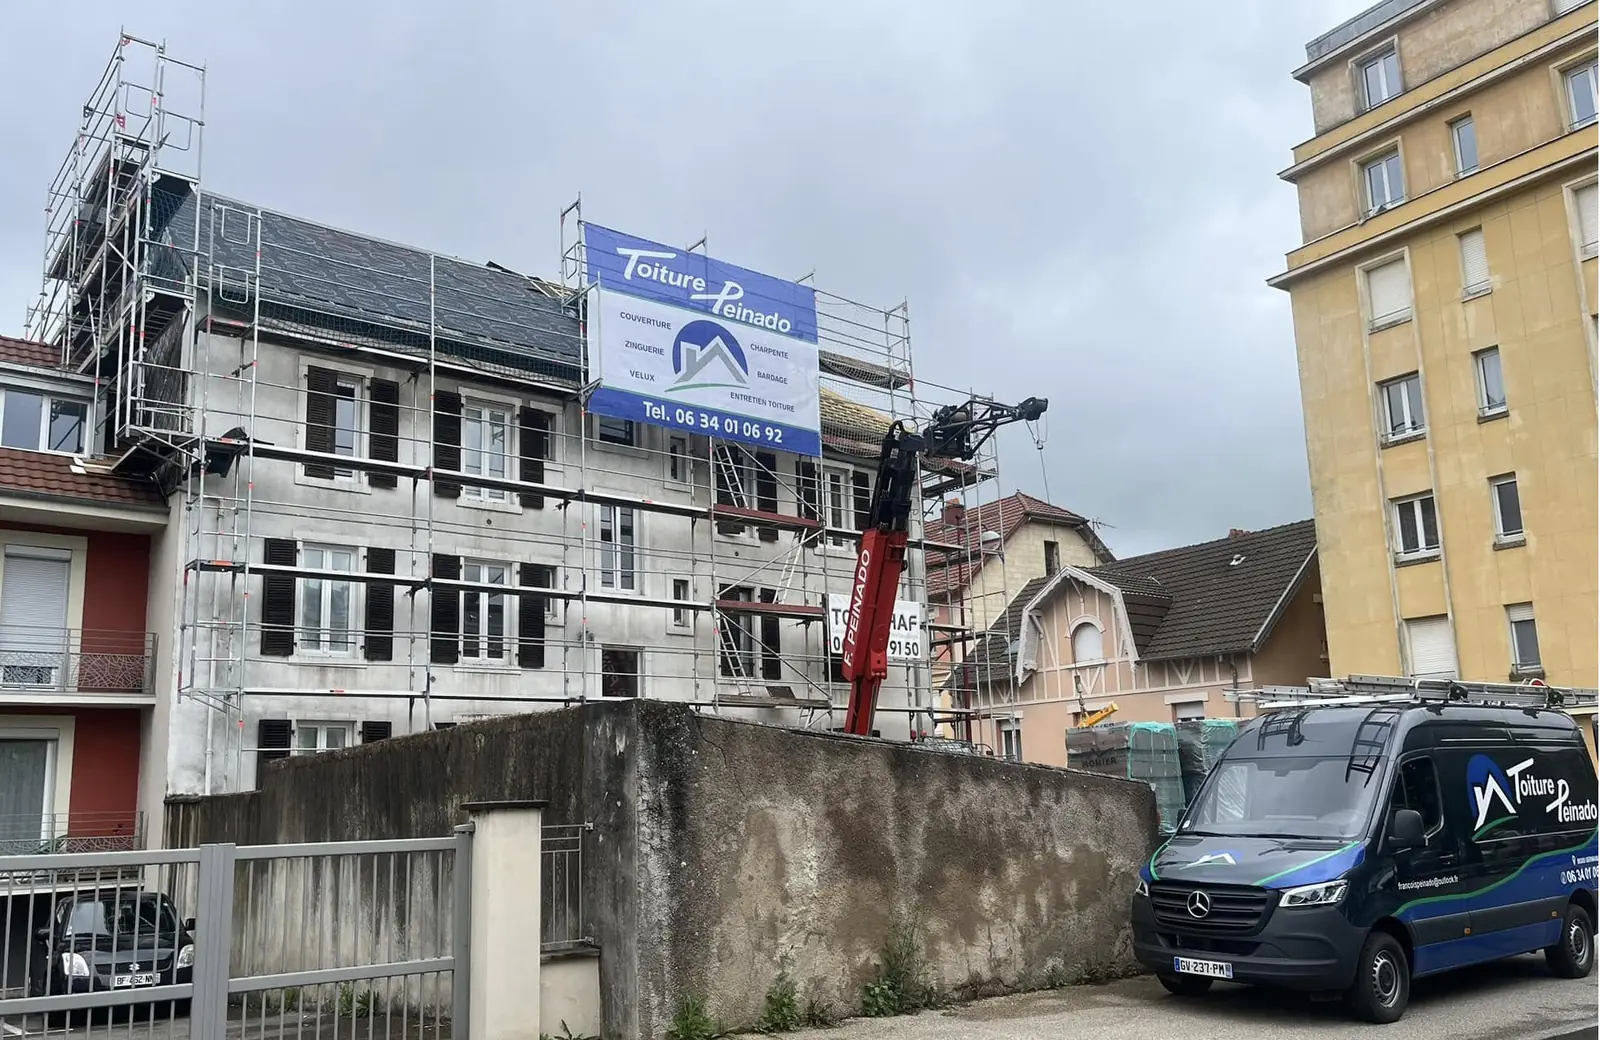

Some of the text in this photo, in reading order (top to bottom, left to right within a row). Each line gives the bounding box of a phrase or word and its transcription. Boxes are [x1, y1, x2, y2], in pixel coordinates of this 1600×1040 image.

[616, 247, 791, 333] Toiture Peinado
[620, 311, 672, 330] COUVERTURE
[625, 340, 665, 356] ZINGUERIE
[750, 343, 789, 360] CHARPENTE
[629, 369, 656, 382] VELUX
[757, 371, 788, 385] BARDAGE
[730, 391, 795, 413] ENTRETIEN TOITURE
[643, 401, 783, 443] Tel. 06 34 01 06 92
[847, 549, 870, 646] PEINADO
[1506, 758, 1555, 804] Toiture
[1545, 779, 1598, 823] Peinado
[1180, 960, 1225, 975] GV-237-PM
